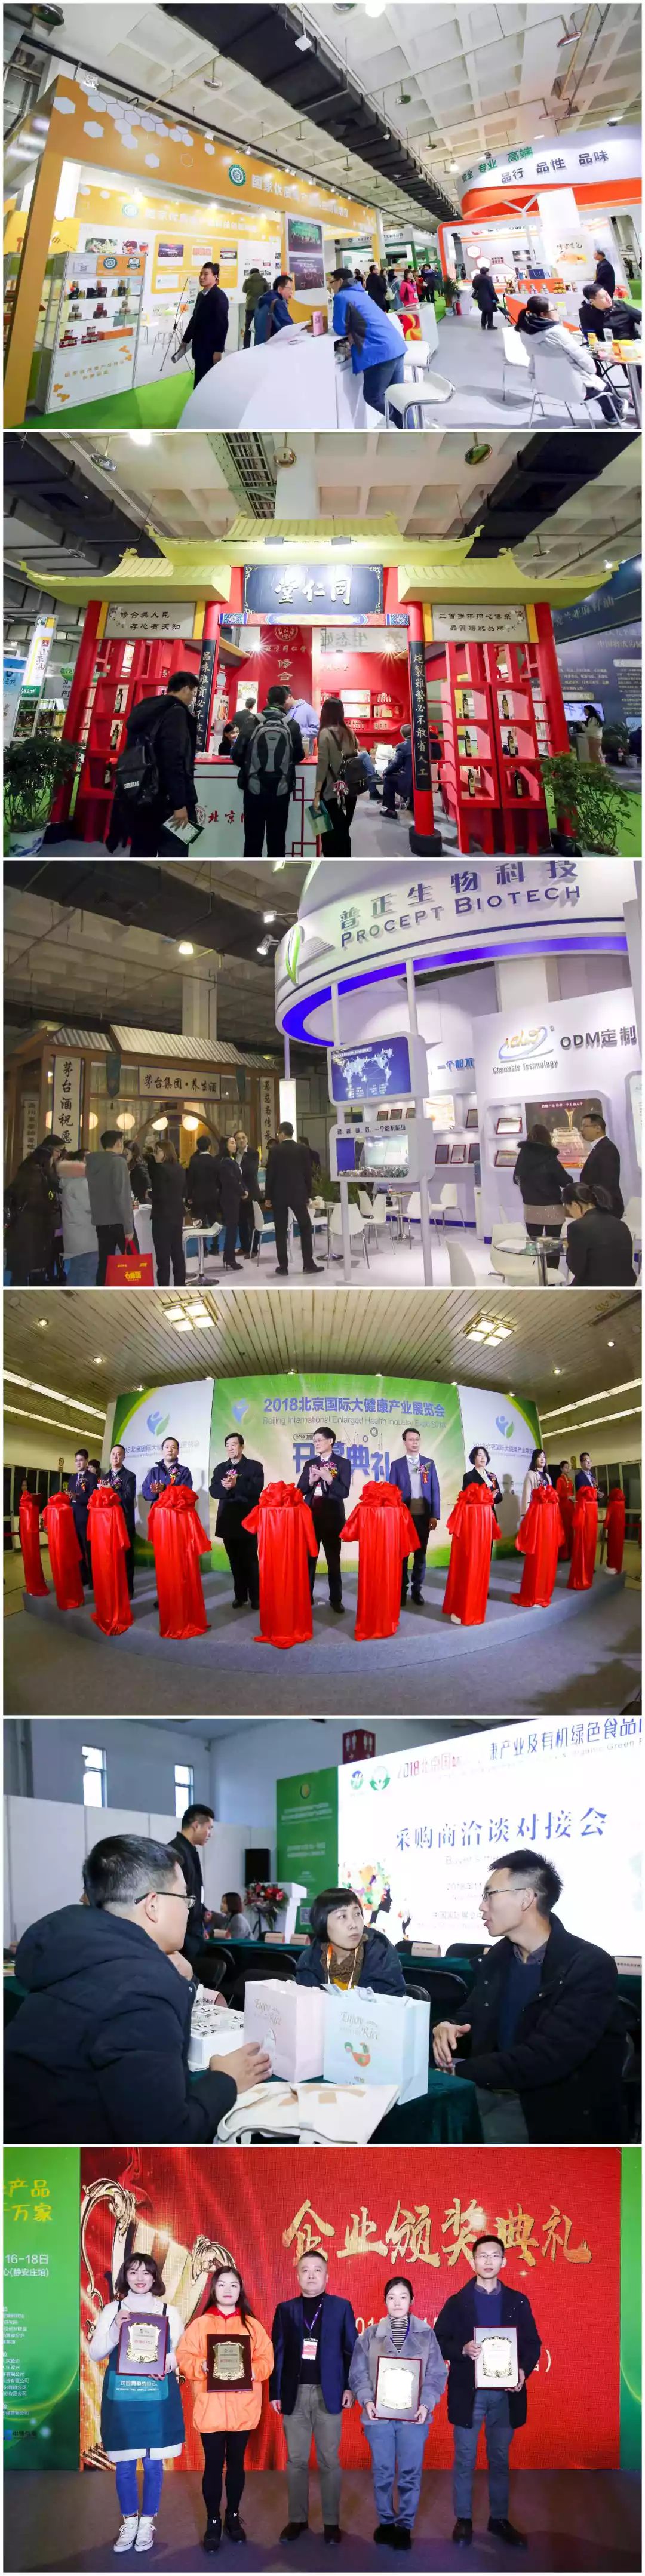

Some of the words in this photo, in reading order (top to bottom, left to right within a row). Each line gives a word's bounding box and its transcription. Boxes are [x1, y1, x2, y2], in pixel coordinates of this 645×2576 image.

[478, 159, 497, 173] 专业
[507, 146, 533, 162] 高端
[501, 168, 524, 183] 品行
[536, 158, 566, 174] 品性
[579, 150, 609, 166] 品味
[340, 862, 579, 930] 普正生物科技
[341, 905, 443, 948] PROCEPT
[455, 886, 580, 914] BIOTECH
[560, 1025, 637, 1049] ODM定制
[493, 1063, 521, 1074] Chewable
[523, 1060, 558, 1071] Technology
[263, 1396, 446, 1418] 2018北京国际大健康产业展览会
[263, 1416, 286, 1425] Beijing
[288, 1415, 331, 1424] International
[332, 1415, 364, 1425] Enlarged
[365, 1416, 386, 1425] Health
[396, 1807, 608, 1851] 采购商洽谈对接会
[4, 2178, 50, 2198] 产品
[282, 2197, 592, 2270] 企业颁奖典礼
